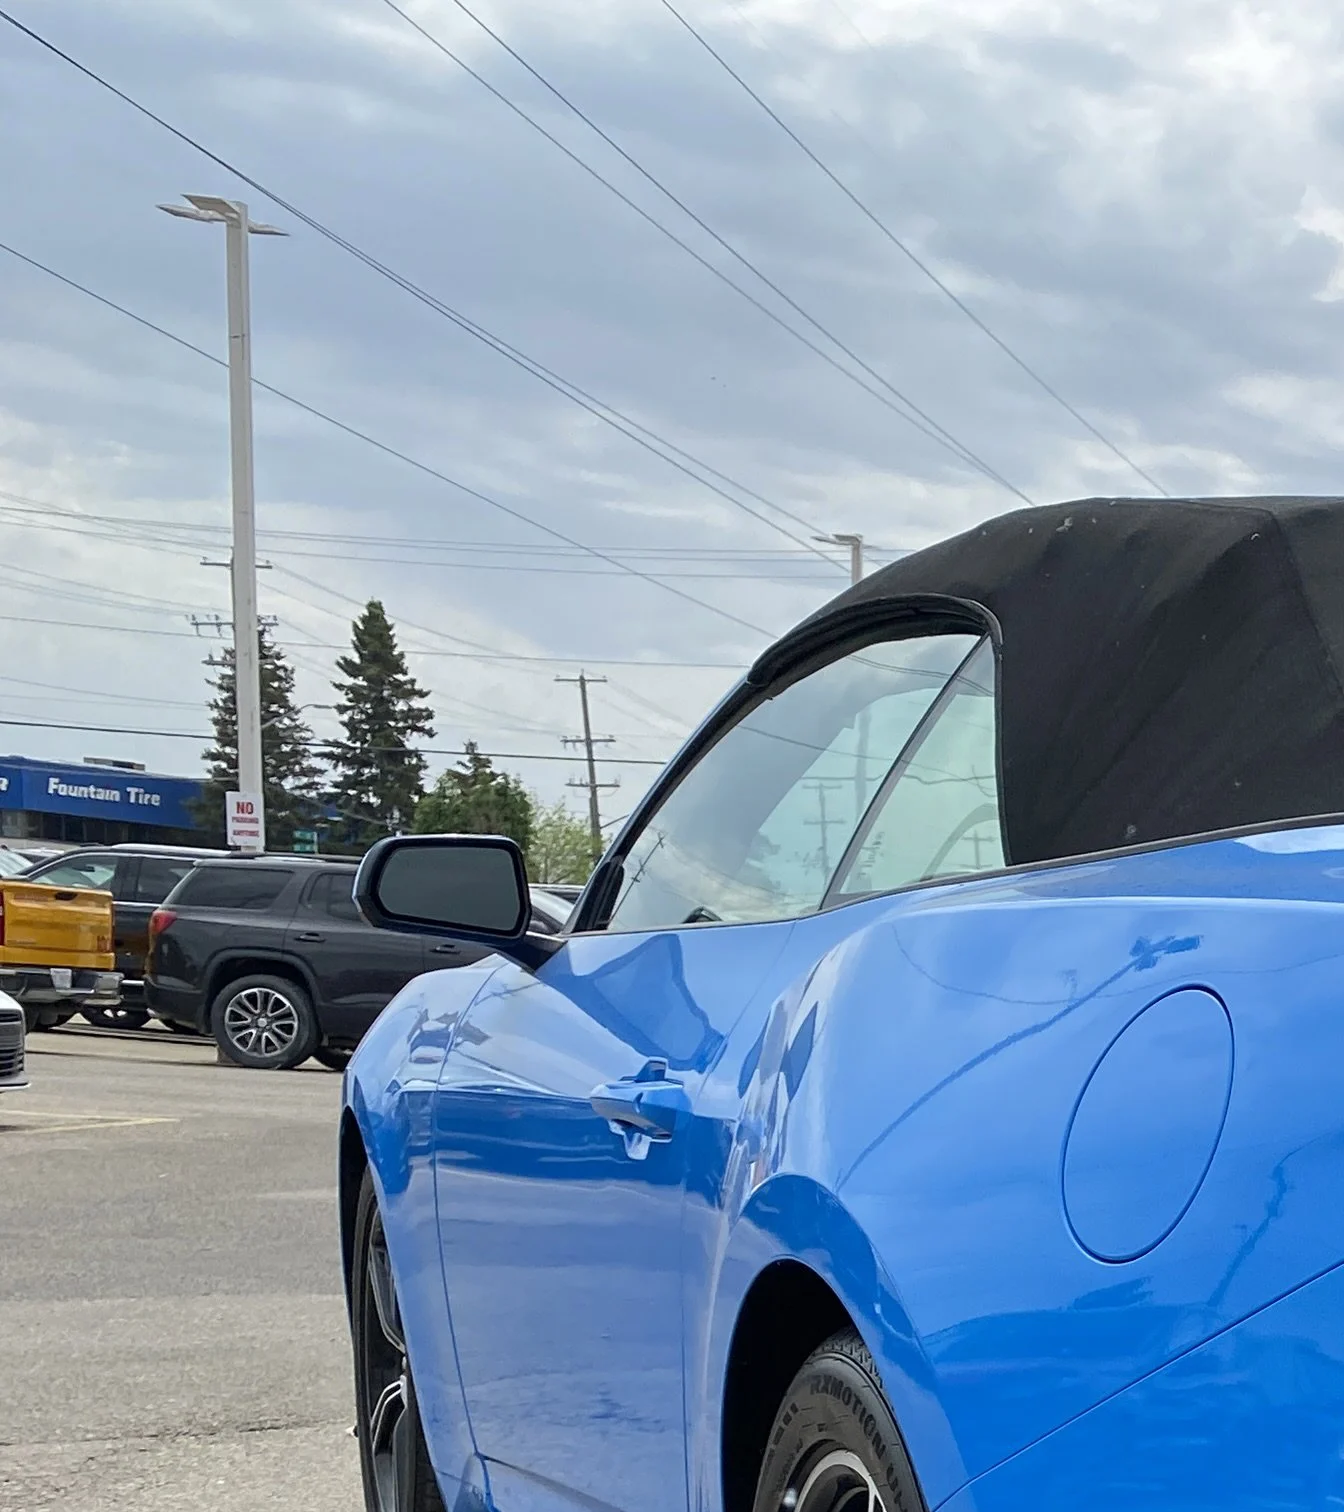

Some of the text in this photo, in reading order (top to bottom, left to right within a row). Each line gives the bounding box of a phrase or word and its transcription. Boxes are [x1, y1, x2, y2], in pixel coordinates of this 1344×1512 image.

[48, 777, 160, 806] Fountain Tire
[236, 801, 254, 814] NO
